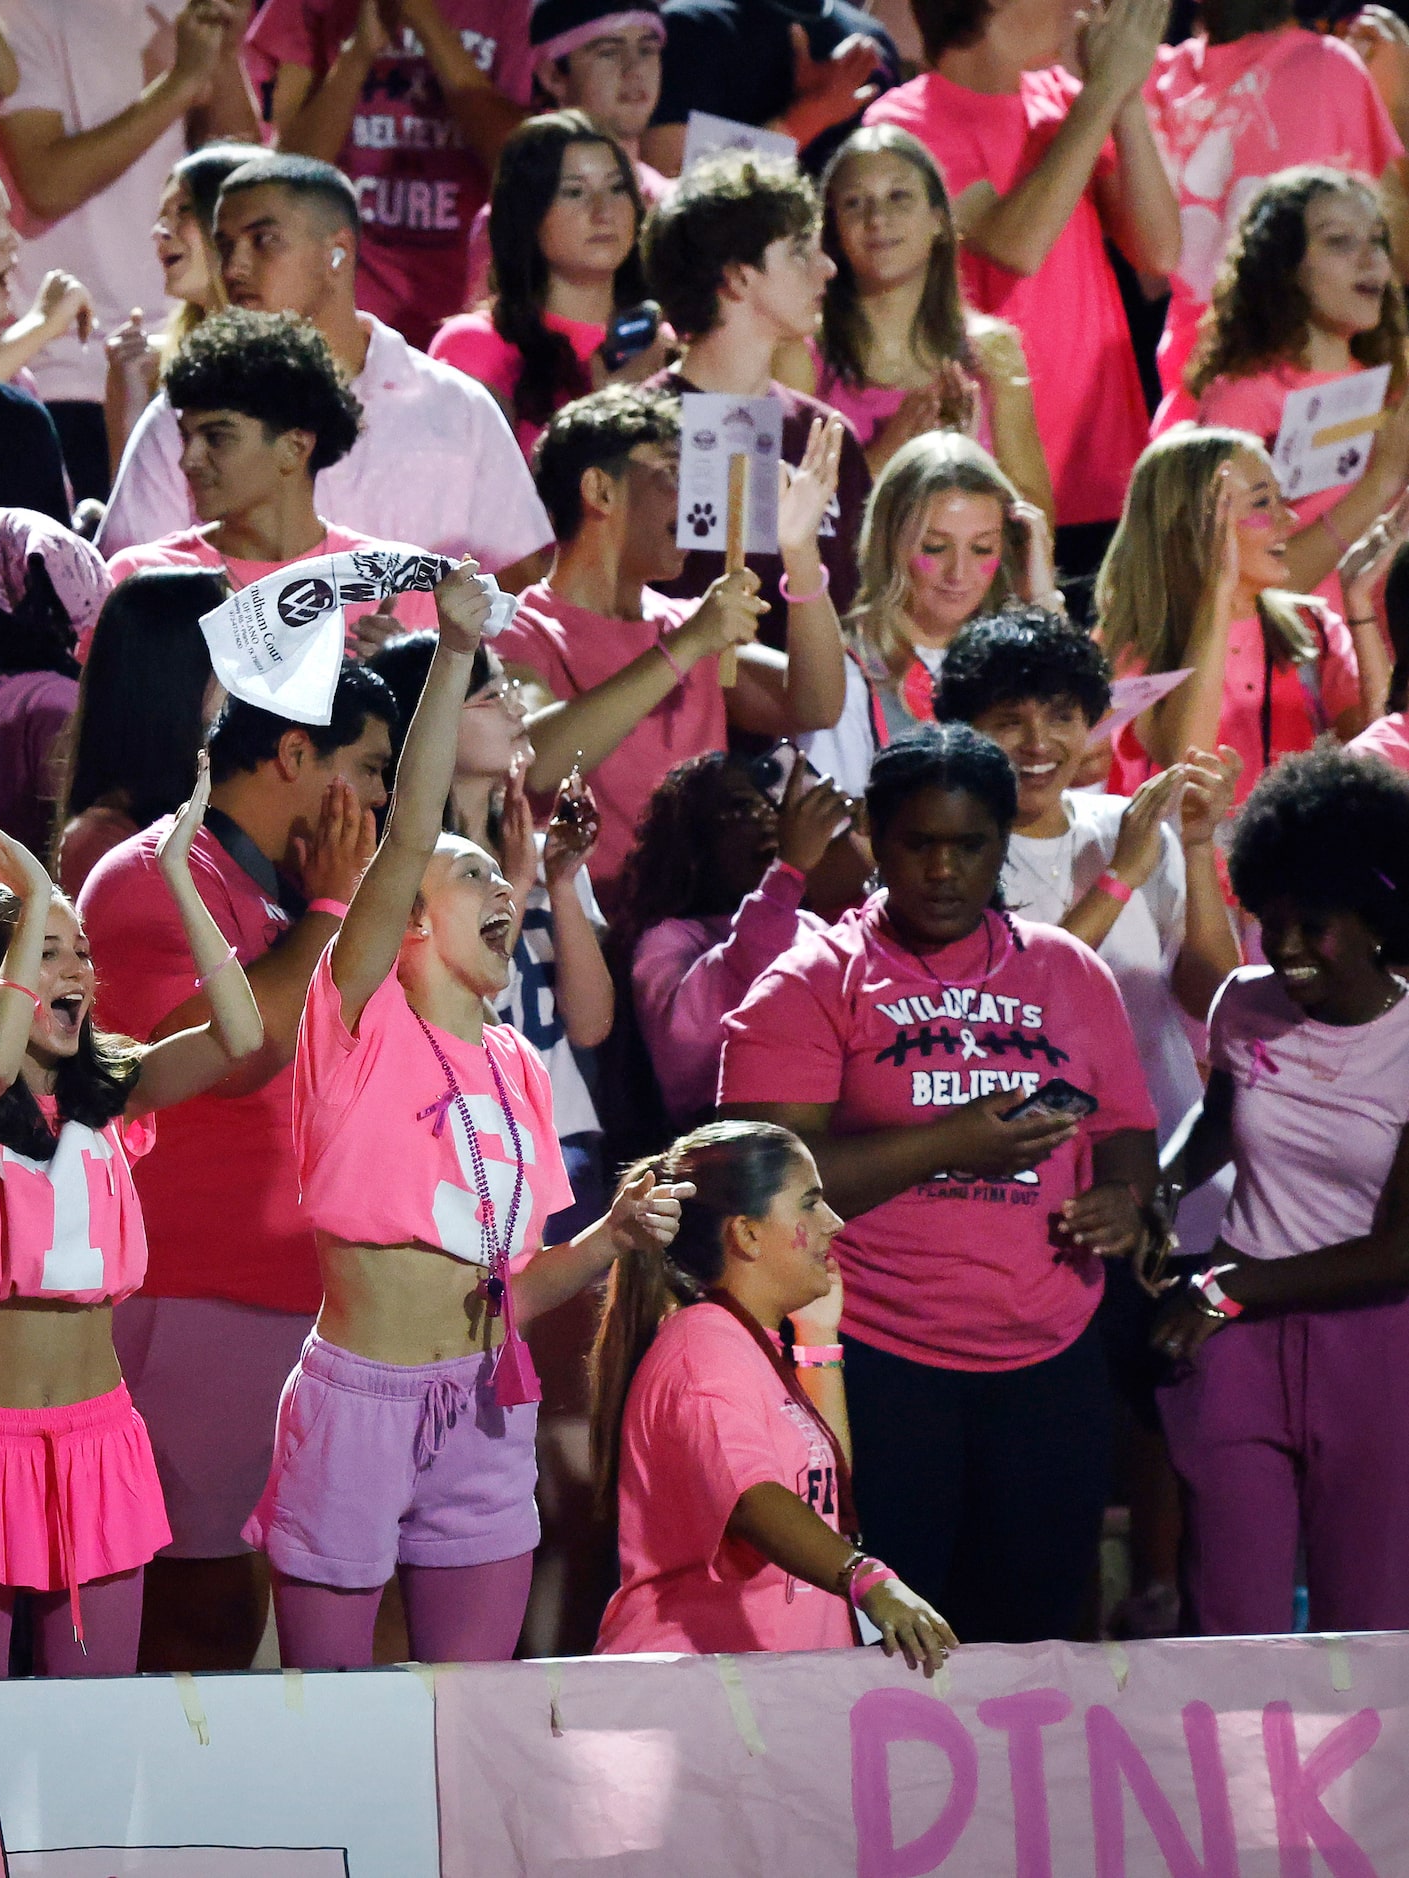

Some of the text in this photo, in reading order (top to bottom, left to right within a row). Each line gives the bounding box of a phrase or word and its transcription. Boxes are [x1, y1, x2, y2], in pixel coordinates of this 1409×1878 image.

[354, 176, 460, 230] CURE
[241, 602, 250, 614] OF
[245, 614, 260, 644] PLANO
[876, 987, 1043, 1029] WILDCATS
[2, 1120, 114, 1290] T
[432, 1094, 535, 1268] S
